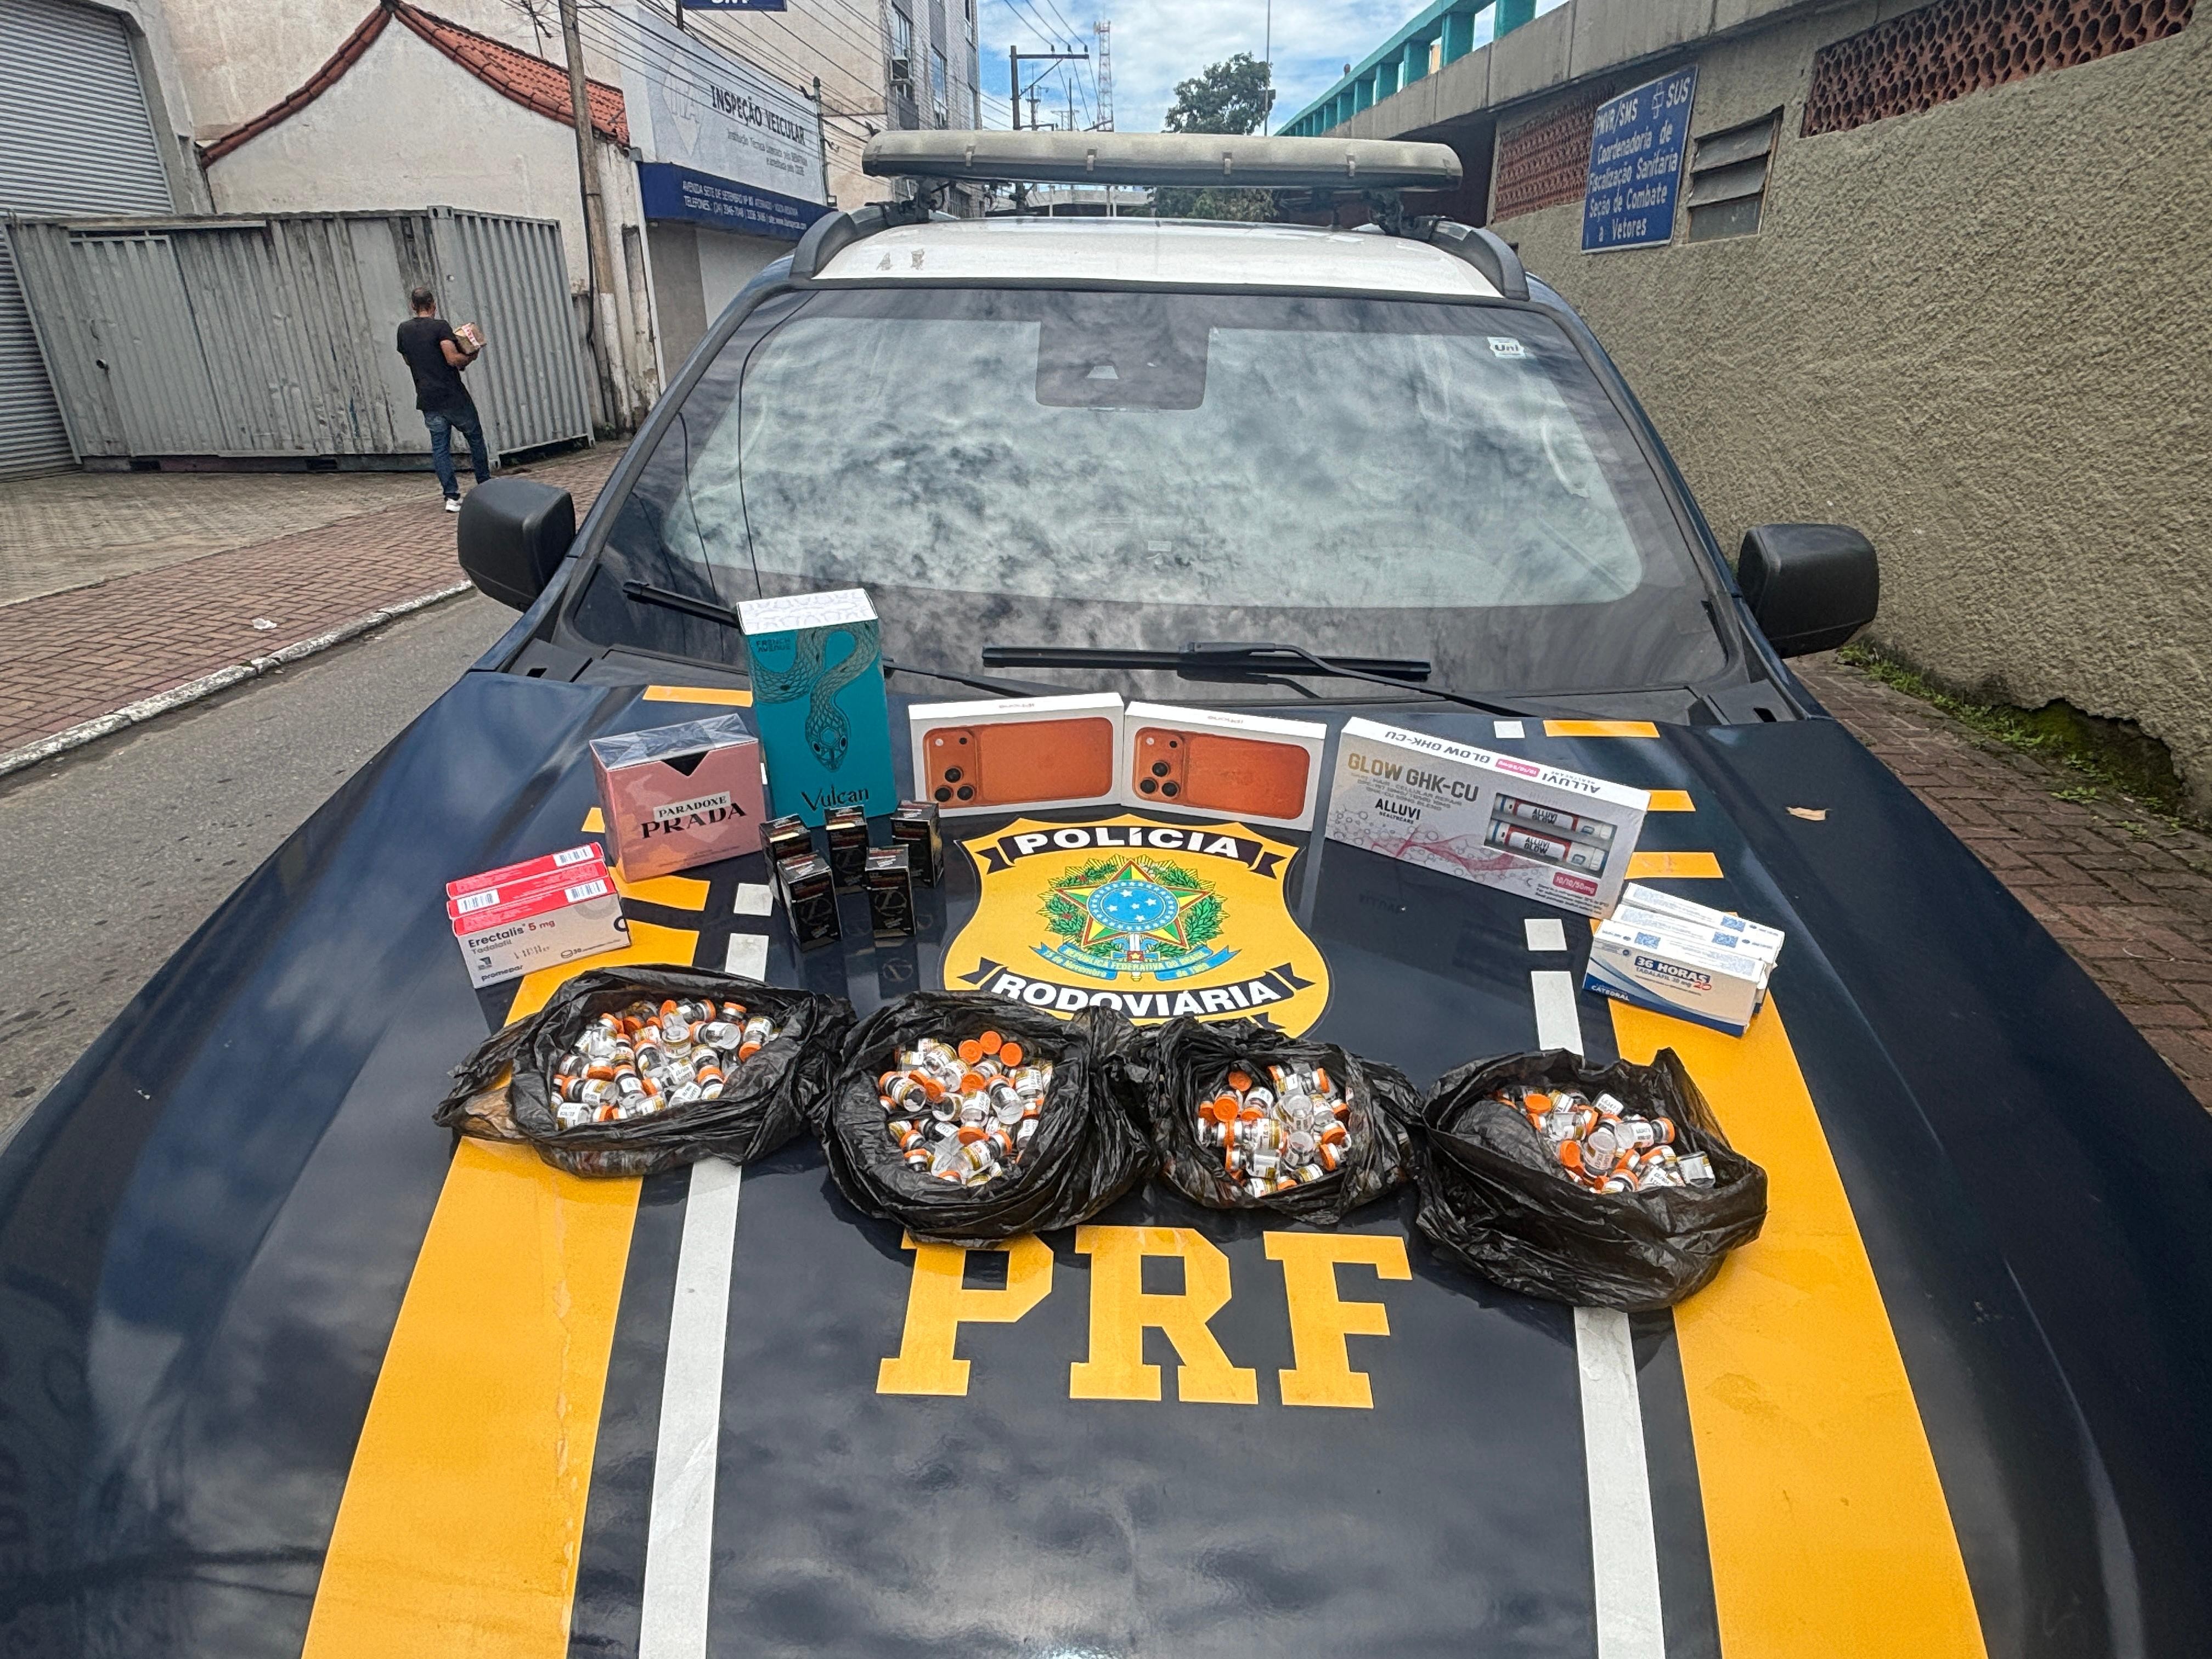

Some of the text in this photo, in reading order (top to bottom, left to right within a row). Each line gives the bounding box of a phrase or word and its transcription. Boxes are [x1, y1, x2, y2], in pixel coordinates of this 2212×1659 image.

[1666, 77, 1690, 108] SUS
[710, 85, 805, 145] INSPEÇÃO VEICULAR
[1596, 98, 1638, 134] PMVR/SMS
[1598, 119, 1673, 165] Coordenadoria de
[1589, 147, 1678, 193] Fiscalização Sanitária
[1589, 182, 1667, 222] Seção de Combate
[1599, 217, 1646, 241] a Vetores
[1385, 731, 1491, 764] GLOW GHK-CU
[1348, 753, 1479, 802] GLOW GHK-CU
[1542, 773, 1601, 793] ALLUVI
[658, 795, 727, 818] PARADOXE
[801, 783, 870, 812] Vulcan
[1375, 798, 1420, 820] ALLUVI
[641, 803, 747, 839] PRADA
[1532, 809, 1558, 820] ALLUVI
[1013, 827, 1240, 859] POLÍCIA
[1524, 843, 1548, 854] GLOW
[1525, 837, 1550, 848] ALLUVI
[468, 925, 524, 948] Erectalis
[528, 922, 536, 932] 5
[539, 920, 555, 929] mg
[1636, 957, 1708, 983] 36 HORAS
[991, 974, 1282, 1017] RODOVIÁRIA
[1592, 985, 1630, 1001] CATEDRAL
[876, 1224, 1413, 1408] PRF
